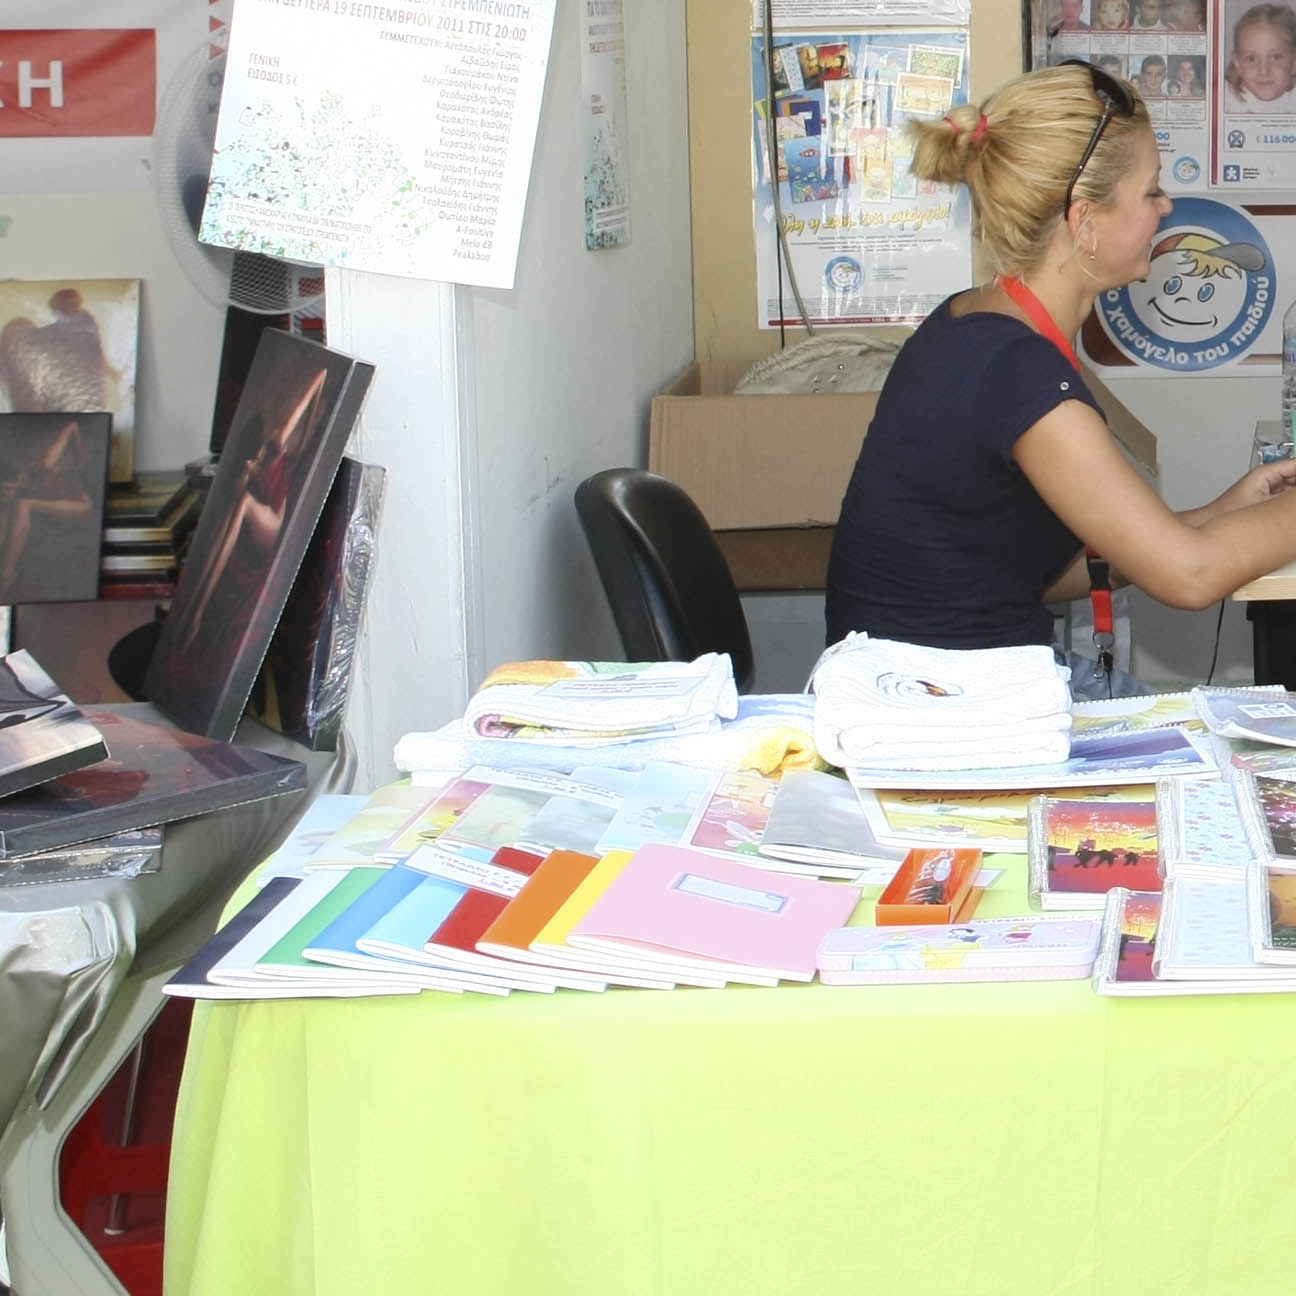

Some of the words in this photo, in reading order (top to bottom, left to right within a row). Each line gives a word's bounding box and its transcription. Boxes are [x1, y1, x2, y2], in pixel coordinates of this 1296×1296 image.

[334, 2, 347, 15] 19
[350, 3, 432, 28] ΣΕΠΤΕΜΒΡΙΟΥ
[437, 16, 464, 33] 2011
[468, 21, 490, 37] ΣΤΙΣ
[495, 24, 527, 42] 20:00
